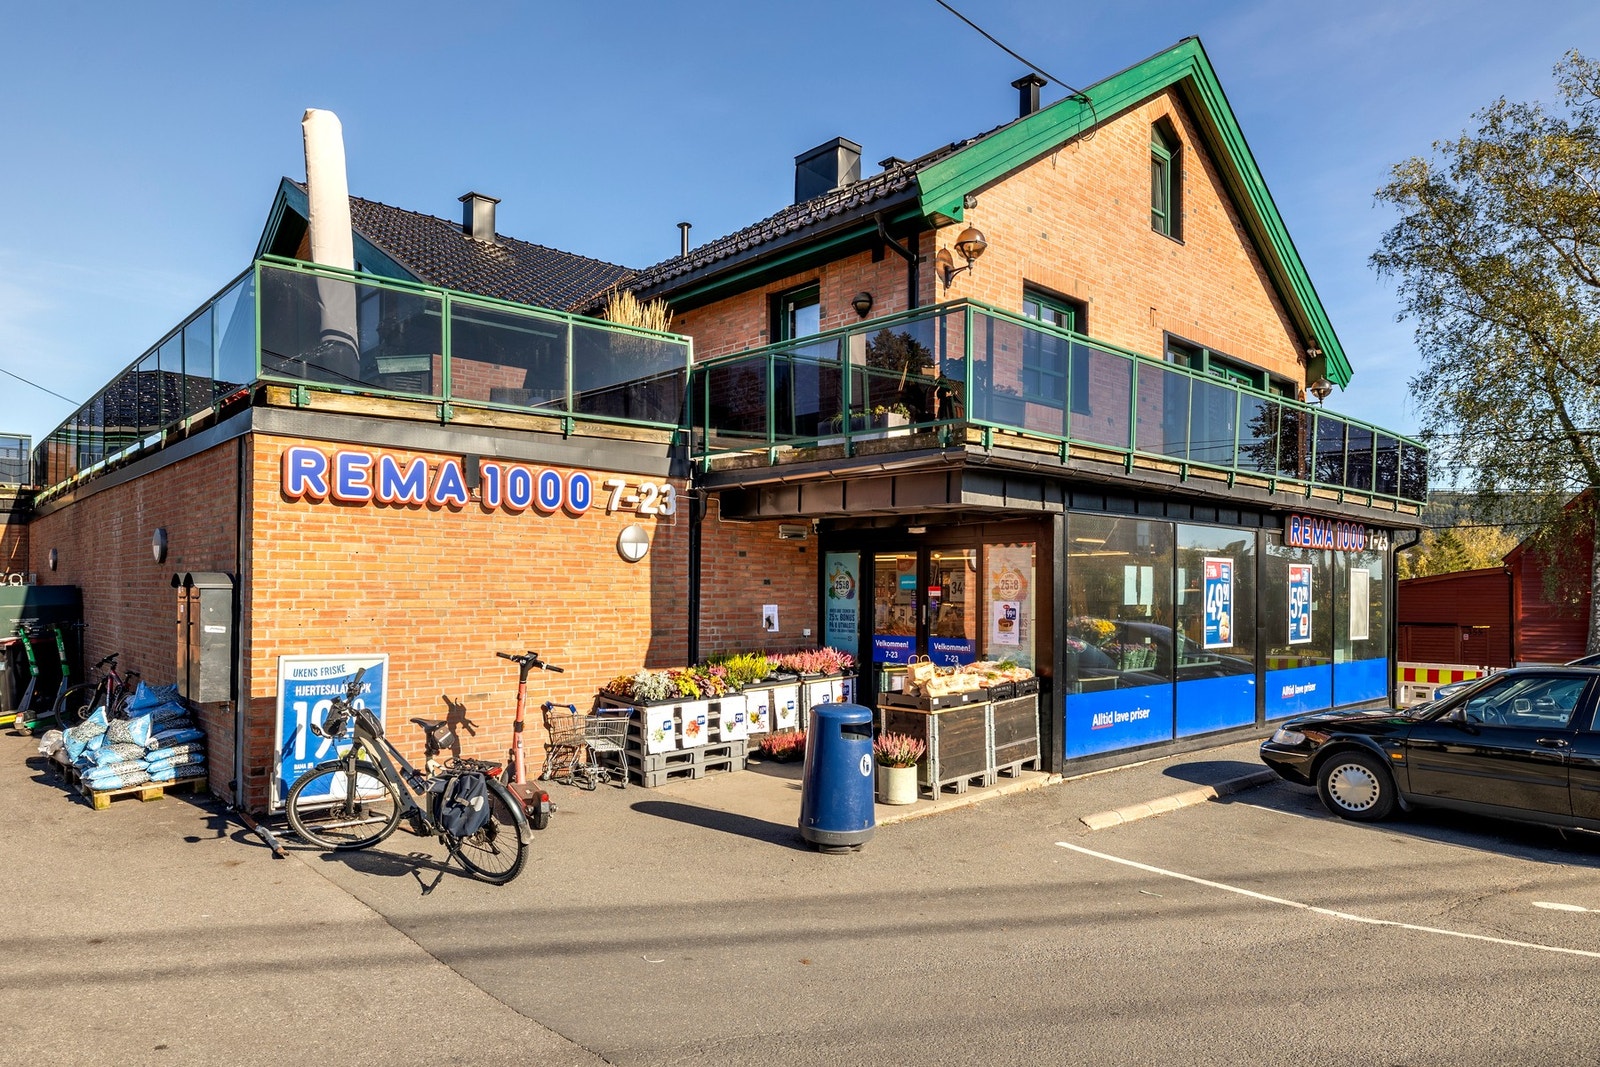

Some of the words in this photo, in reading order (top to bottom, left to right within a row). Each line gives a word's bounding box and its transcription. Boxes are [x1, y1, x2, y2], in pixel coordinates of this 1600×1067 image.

[283, 445, 470, 507] REMA
[480, 460, 593, 515] 1000
[604, 479, 676, 516] 7-23
[1290, 514, 1334, 549] REMA
[1336, 520, 1365, 552] 1000
[1368, 528, 1388, 551] 7-23
[1207, 583, 1223, 621] 49
[1291, 587, 1302, 618] 59
[875, 639, 909, 648] Velkommen!
[934, 642, 971, 652] Velkommen!
[945, 655, 958, 663] 7-23
[293, 668, 318, 677] UKENS
[320, 664, 346, 676] FRISKE
[1282, 684, 1295, 696] Alltid
[1295, 684, 1304, 694] lave
[1304, 682, 1316, 694] priser
[1092, 711, 1113, 726] Alltid
[1114, 710, 1129, 723] lave
[1130, 707, 1150, 723] priser
